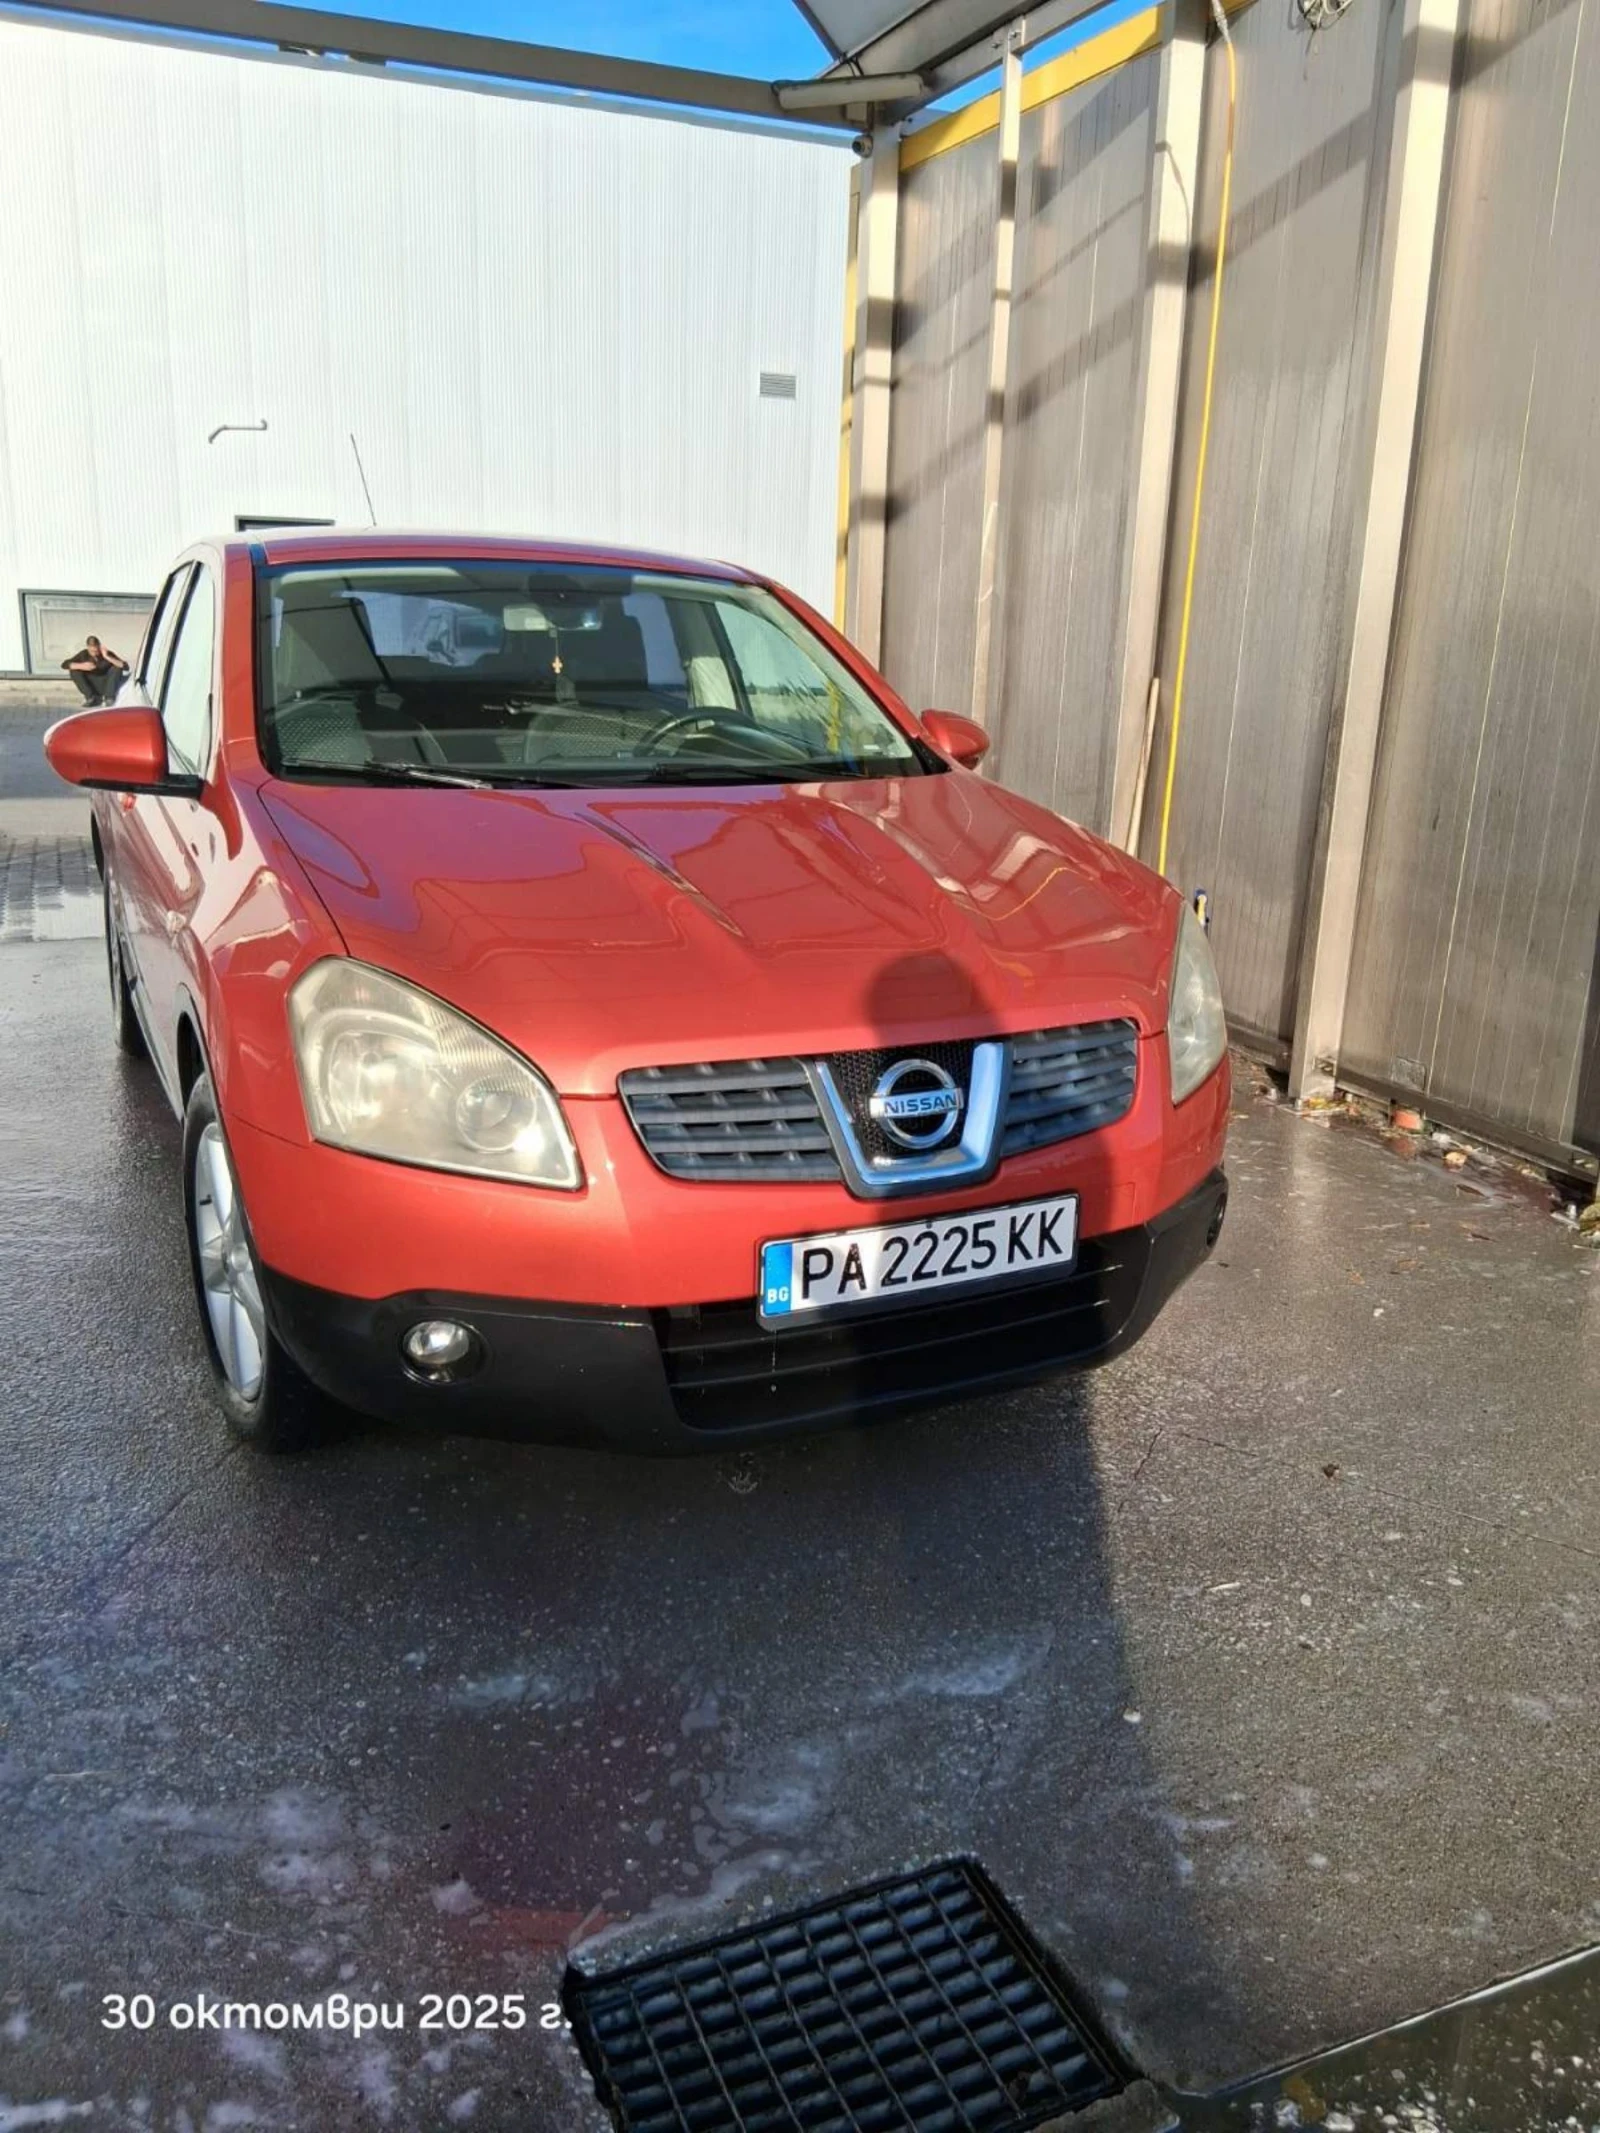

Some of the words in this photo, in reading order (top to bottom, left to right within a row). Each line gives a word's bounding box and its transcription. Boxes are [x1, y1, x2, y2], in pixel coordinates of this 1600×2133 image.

[884, 1093, 957, 1114] NISSAN
[801, 1242, 868, 1300] PA
[881, 1220, 997, 1288] 2225
[1007, 1206, 1066, 1264] KK
[766, 1287, 790, 1304] BG
